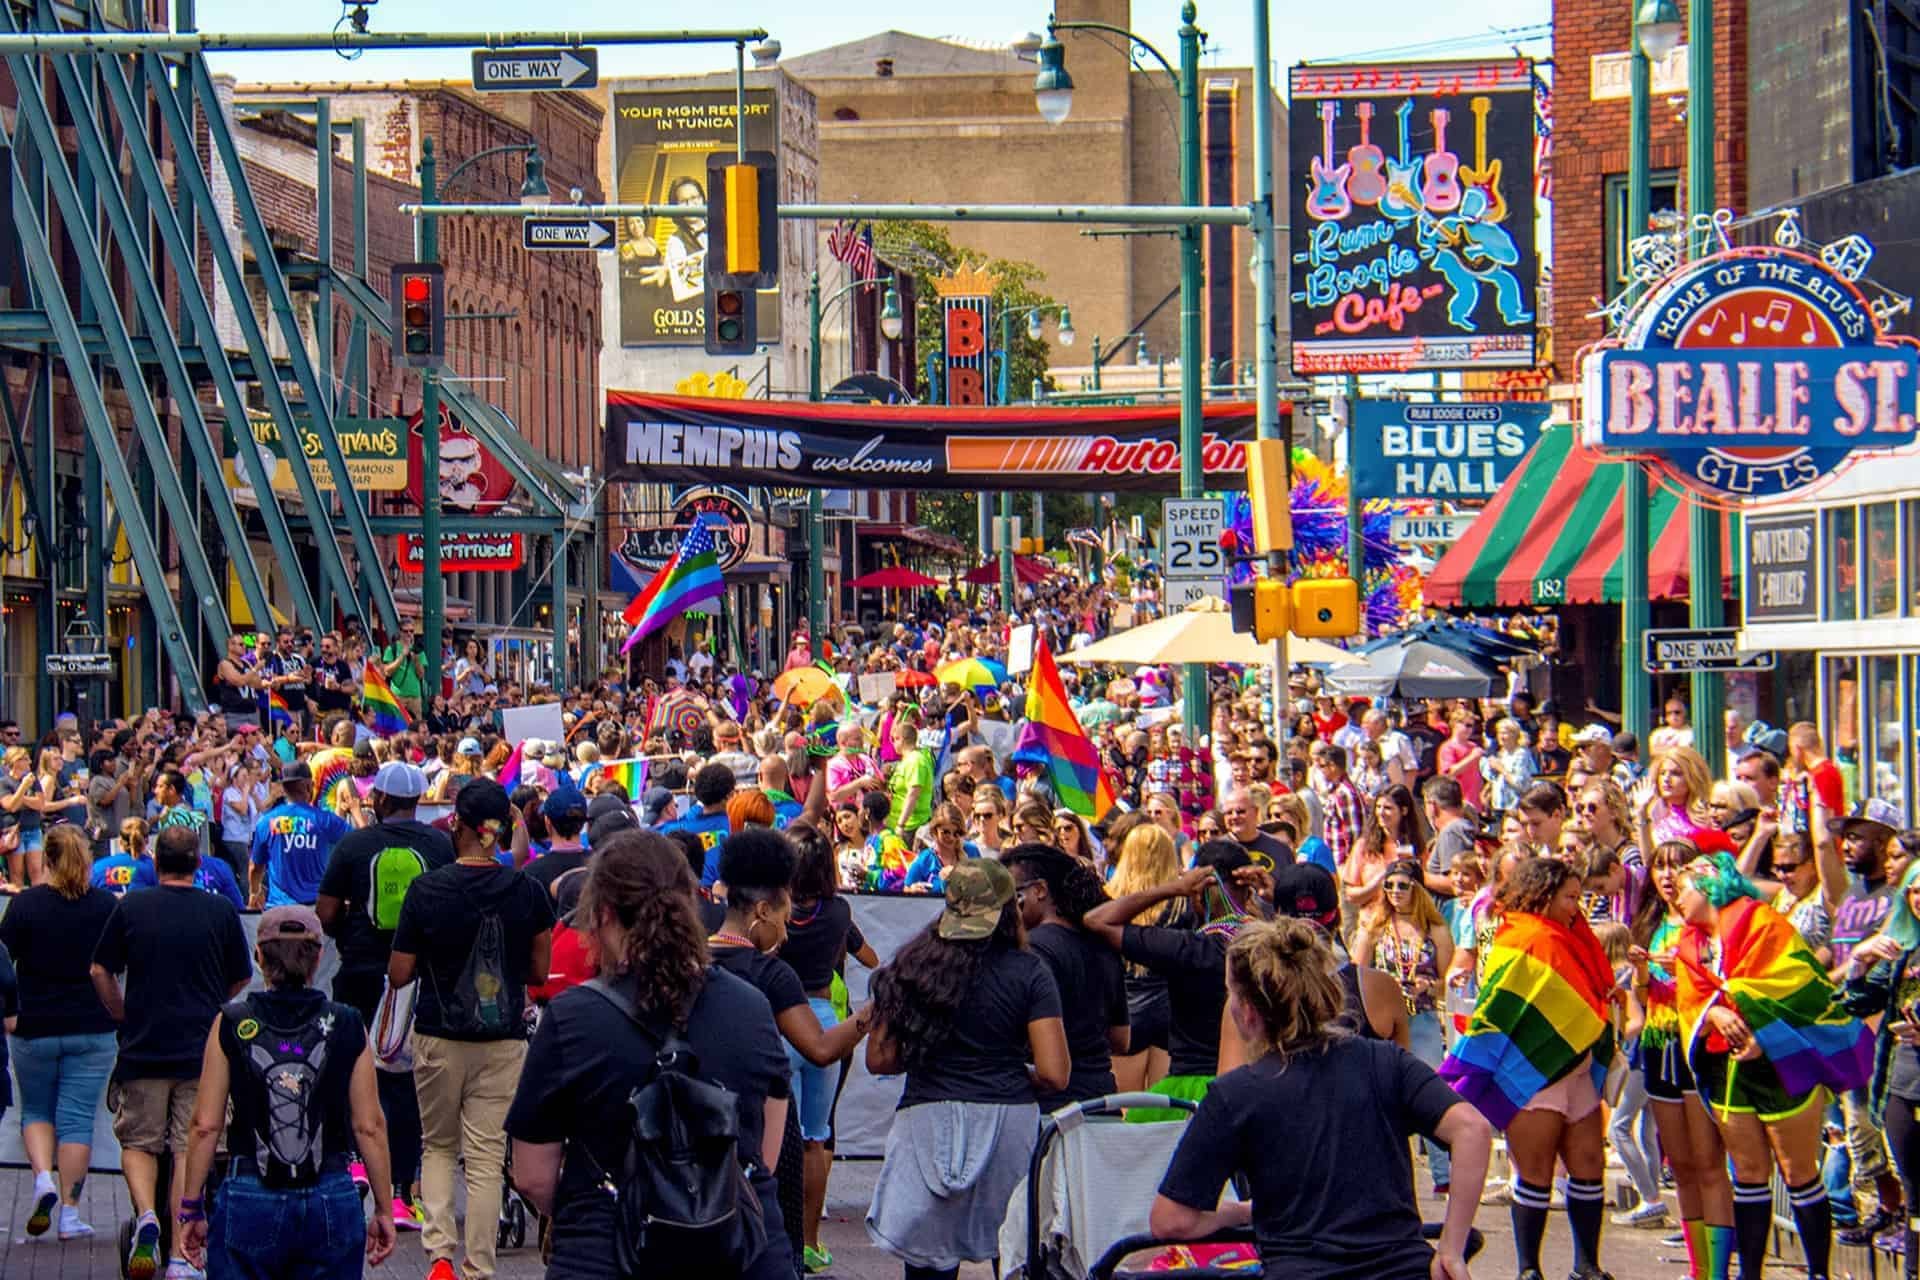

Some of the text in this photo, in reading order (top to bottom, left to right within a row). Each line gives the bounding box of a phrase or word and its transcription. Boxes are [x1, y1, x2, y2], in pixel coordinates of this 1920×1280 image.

[488, 62, 561, 78] ONE WAY
[620, 107, 662, 118] YOUR
[667, 106, 704, 117] MGM
[657, 117, 734, 130] IN TUNICA
[535, 226, 589, 240] ONE WAY
[1656, 263, 1865, 339] HOME OF THE BLUES
[653, 308, 694, 327] GOLD
[1607, 360, 1811, 435] BEALE
[1833, 360, 1916, 436] ST.
[626, 422, 803, 471] MEMPHIS
[812, 434, 934, 474] welcomes
[1382, 423, 1525, 457] BLUES
[1396, 461, 1504, 494] HALL
[1697, 455, 1819, 493] GIFTS
[1168, 508, 1220, 520] SPEED
[1174, 524, 1216, 536] LIMIT
[1401, 521, 1454, 537] JUKE
[1171, 541, 1219, 567] 25
[1185, 588, 1204, 600] NO
[1538, 579, 1562, 598] 182
[1663, 640, 1735, 659] ONE WAY
[283, 832, 317, 853] you
